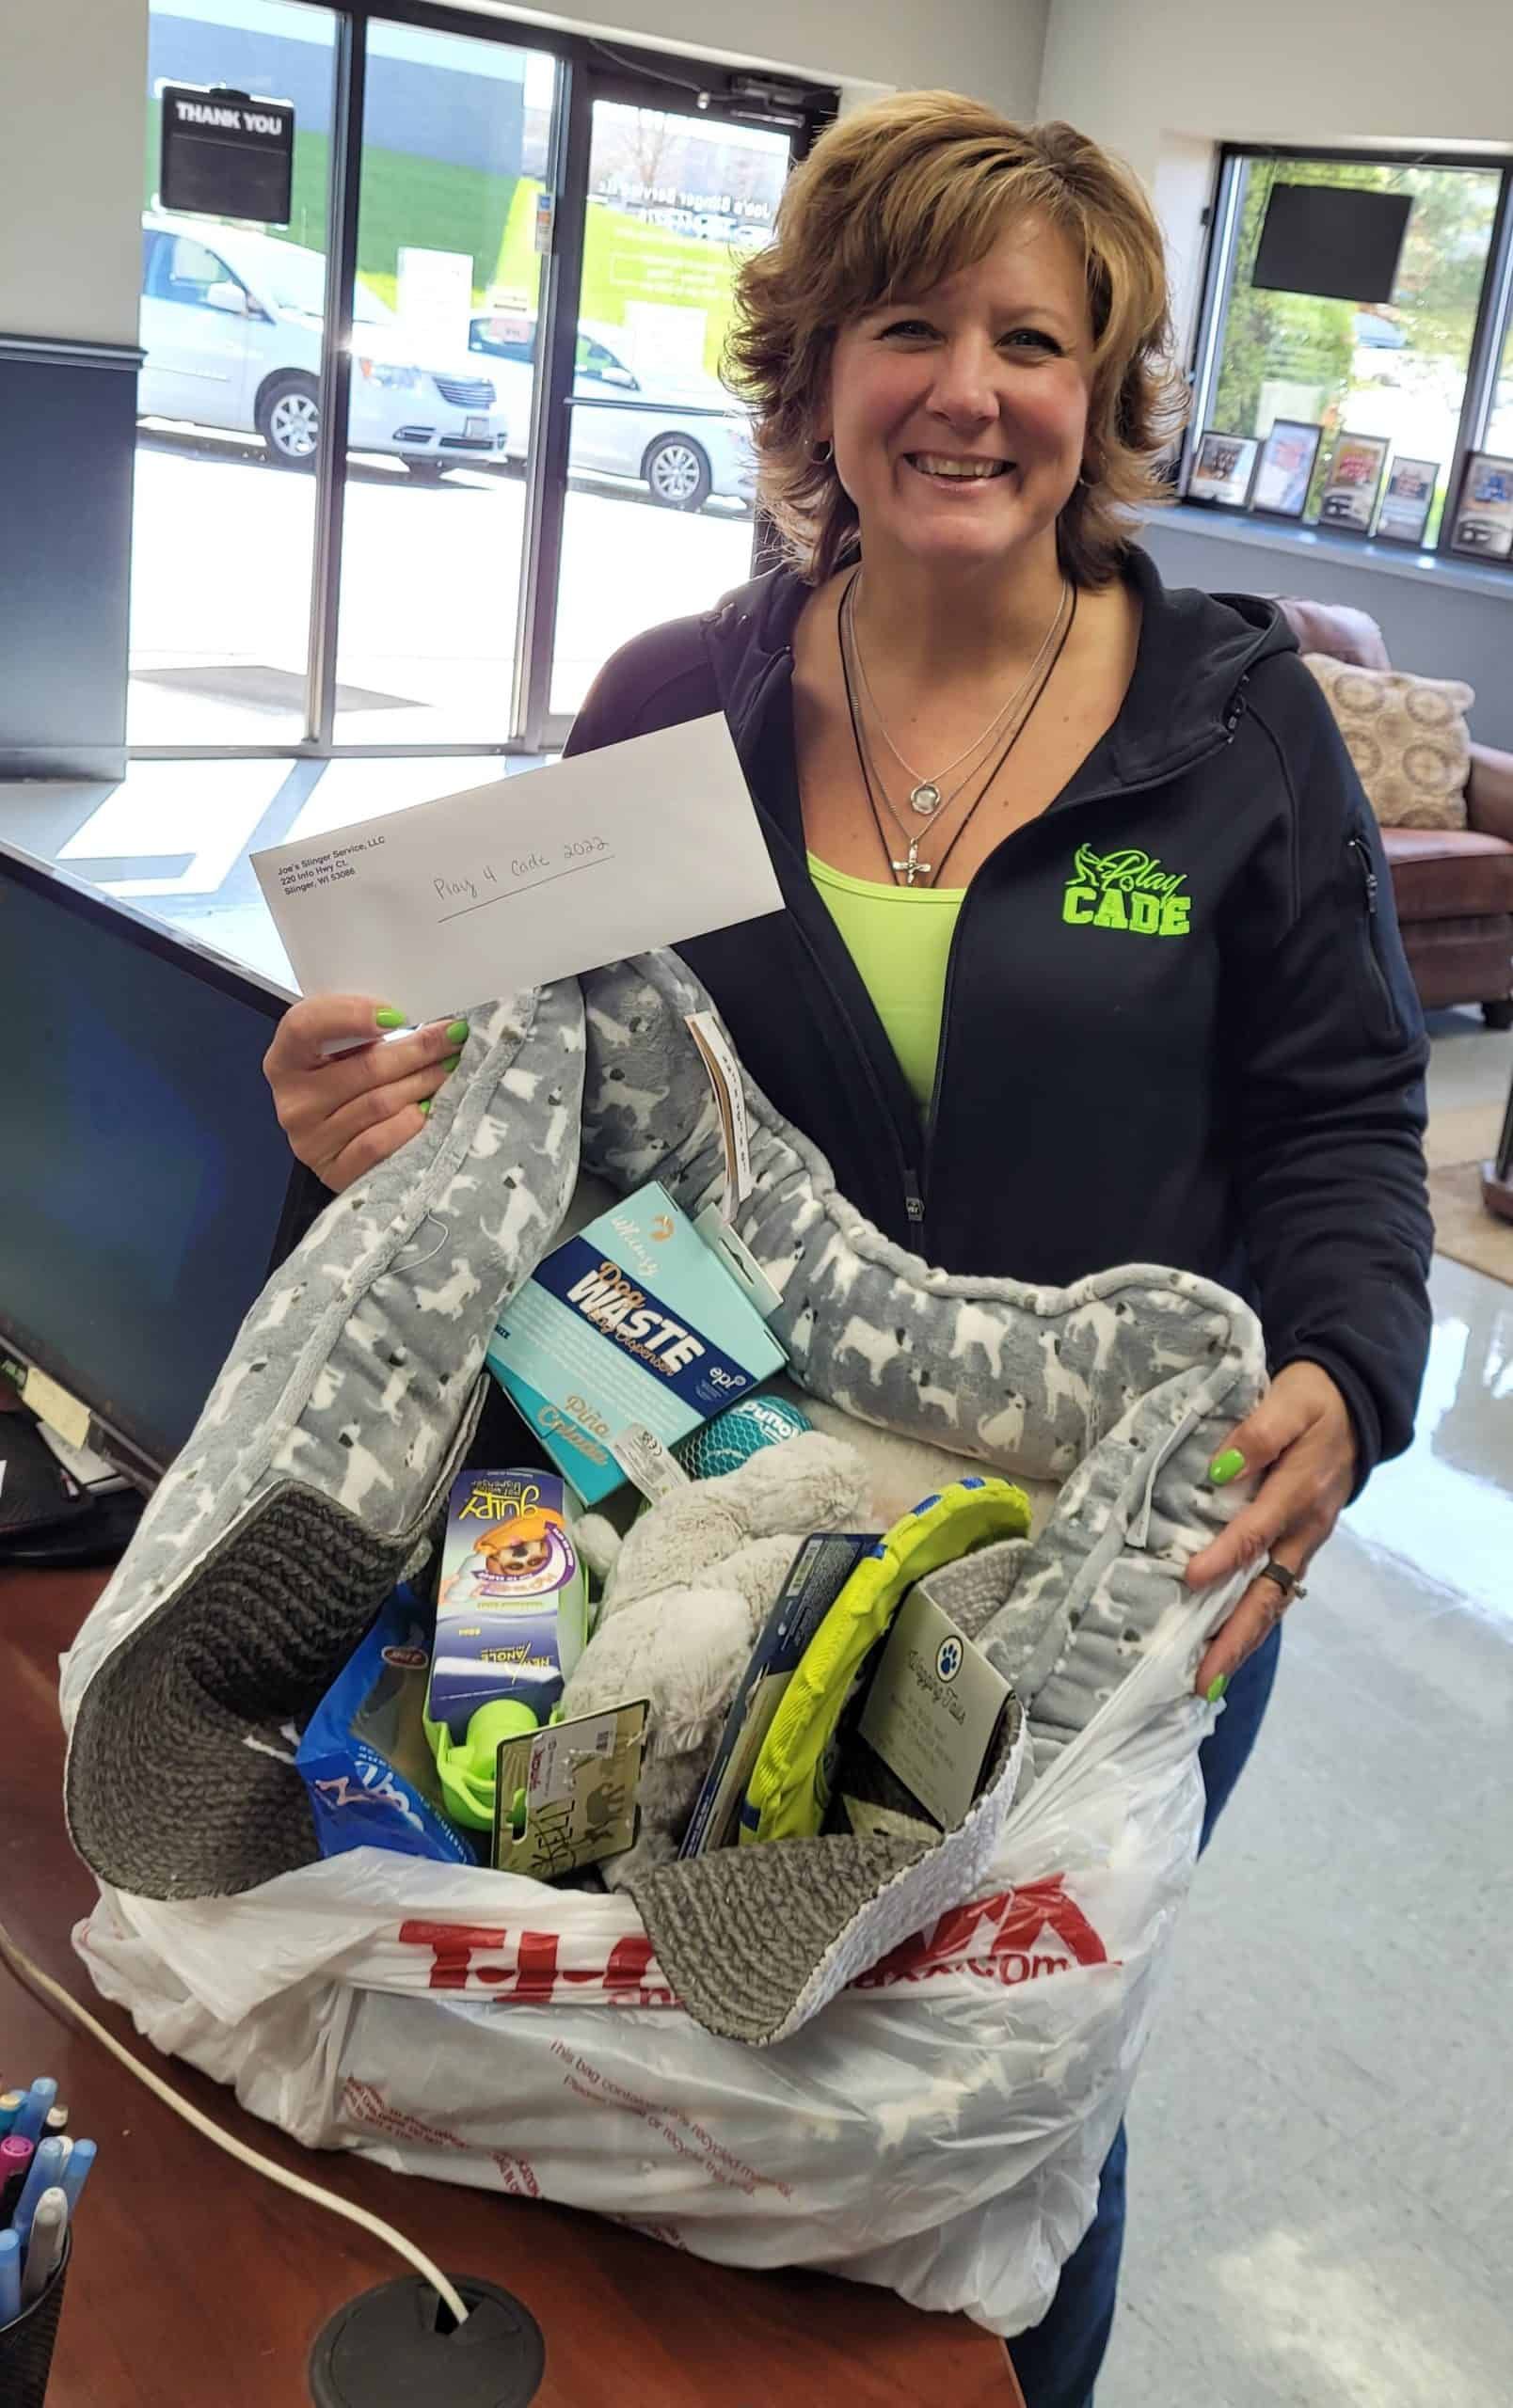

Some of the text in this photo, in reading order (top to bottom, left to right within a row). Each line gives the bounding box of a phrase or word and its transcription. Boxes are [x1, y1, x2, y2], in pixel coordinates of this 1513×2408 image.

[175, 100, 282, 136] THANK YOU
[278, 863, 300, 876] Joe's
[301, 853, 331, 868] Slinger
[367, 835, 386, 848] LLC
[280, 875, 296, 886] 220
[315, 863, 335, 876] Hwy
[483, 864, 498, 883] 4
[563, 835, 611, 859] 2022
[1095, 848, 1188, 910] Play
[284, 880, 318, 895] Slinger,
[316, 876, 330, 886] WI
[1062, 886, 1191, 936] CADE
[598, 1260, 646, 1310] Dog
[566, 1269, 706, 1374] WASTE
